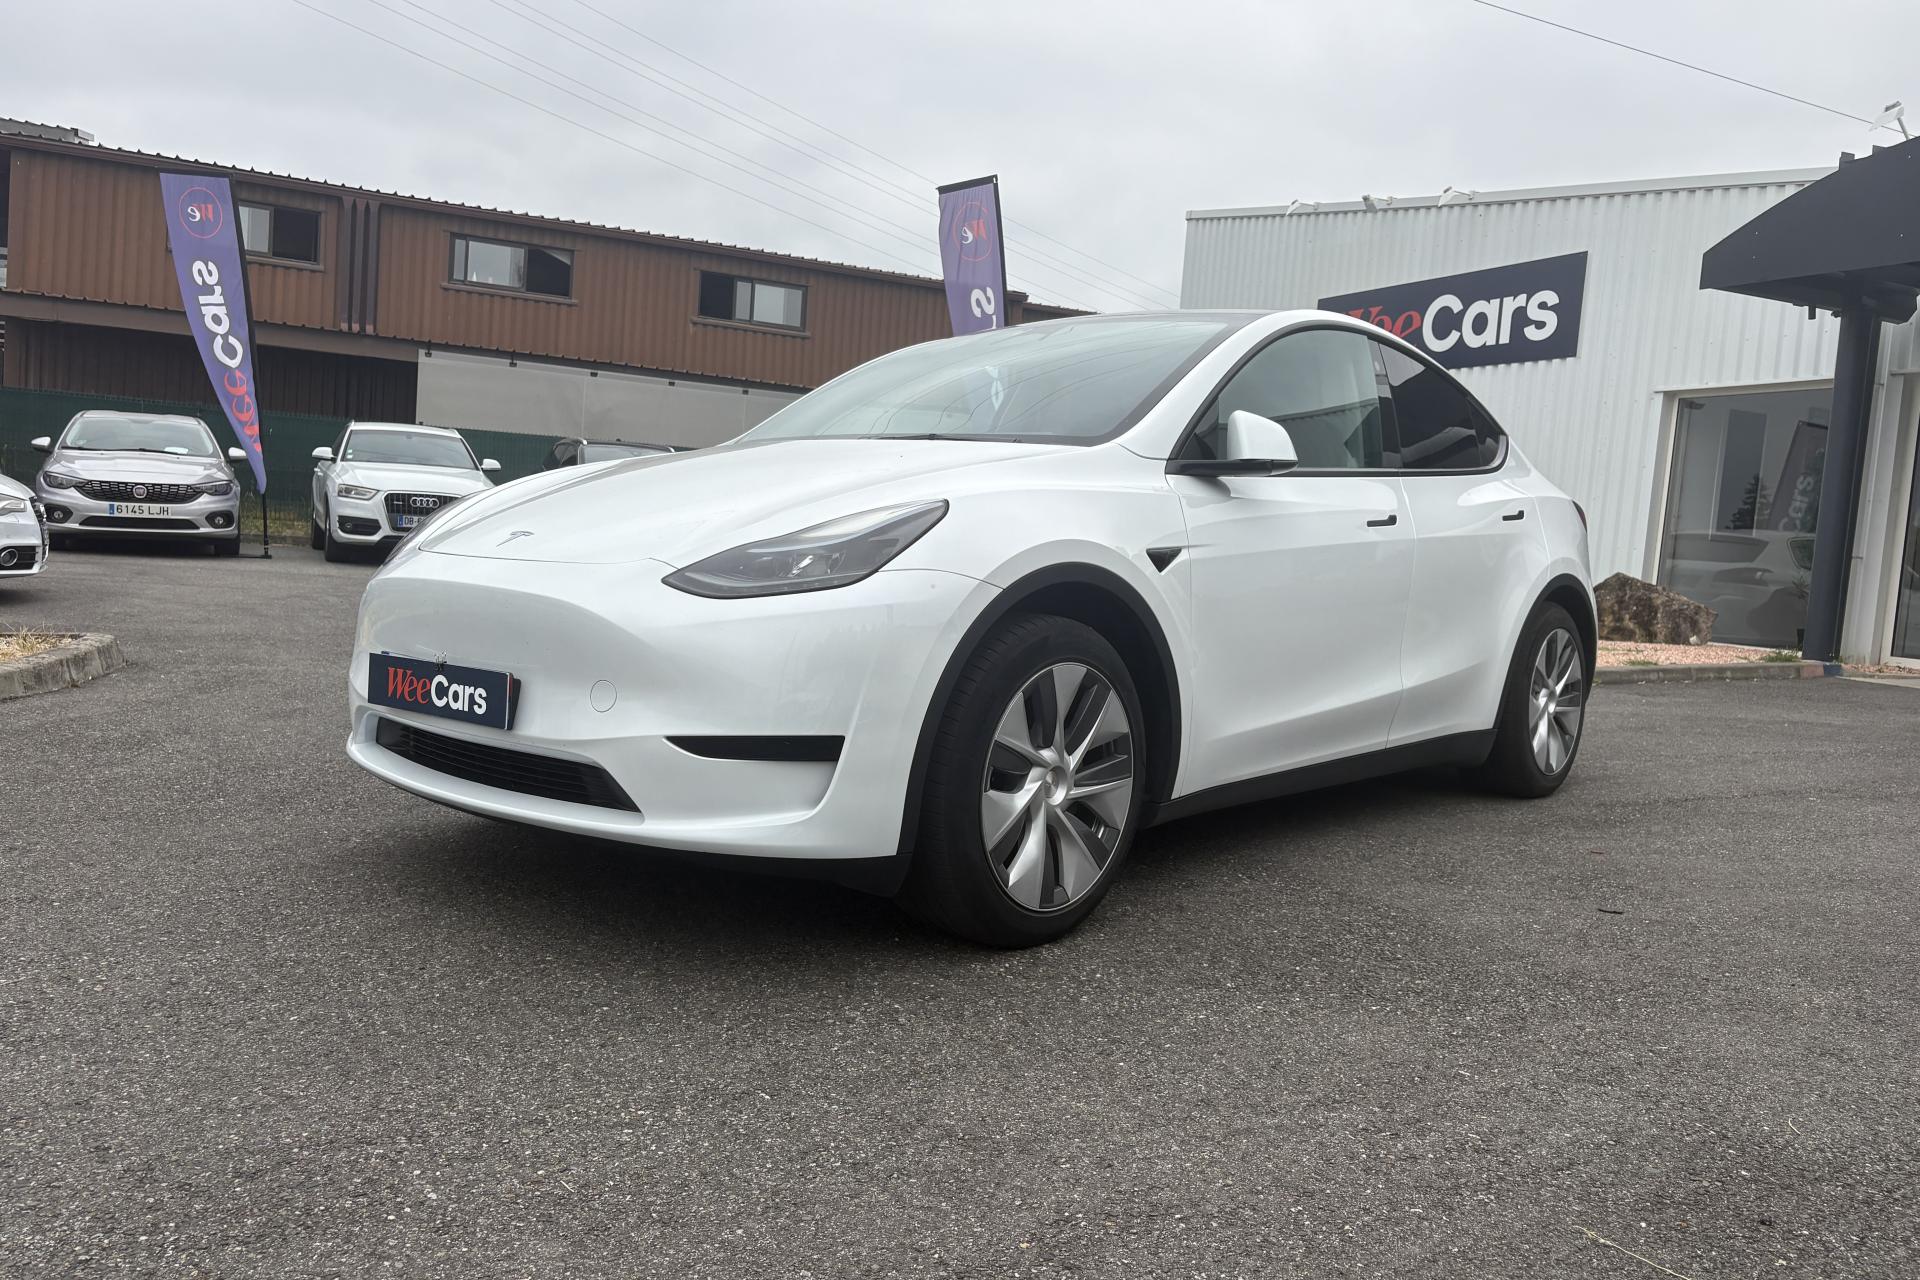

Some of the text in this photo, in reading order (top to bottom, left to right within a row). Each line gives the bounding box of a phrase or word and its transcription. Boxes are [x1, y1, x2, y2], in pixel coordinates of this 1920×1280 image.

[116, 504, 169, 516] 6145 LJH
[387, 666, 488, 715] WeeCars
